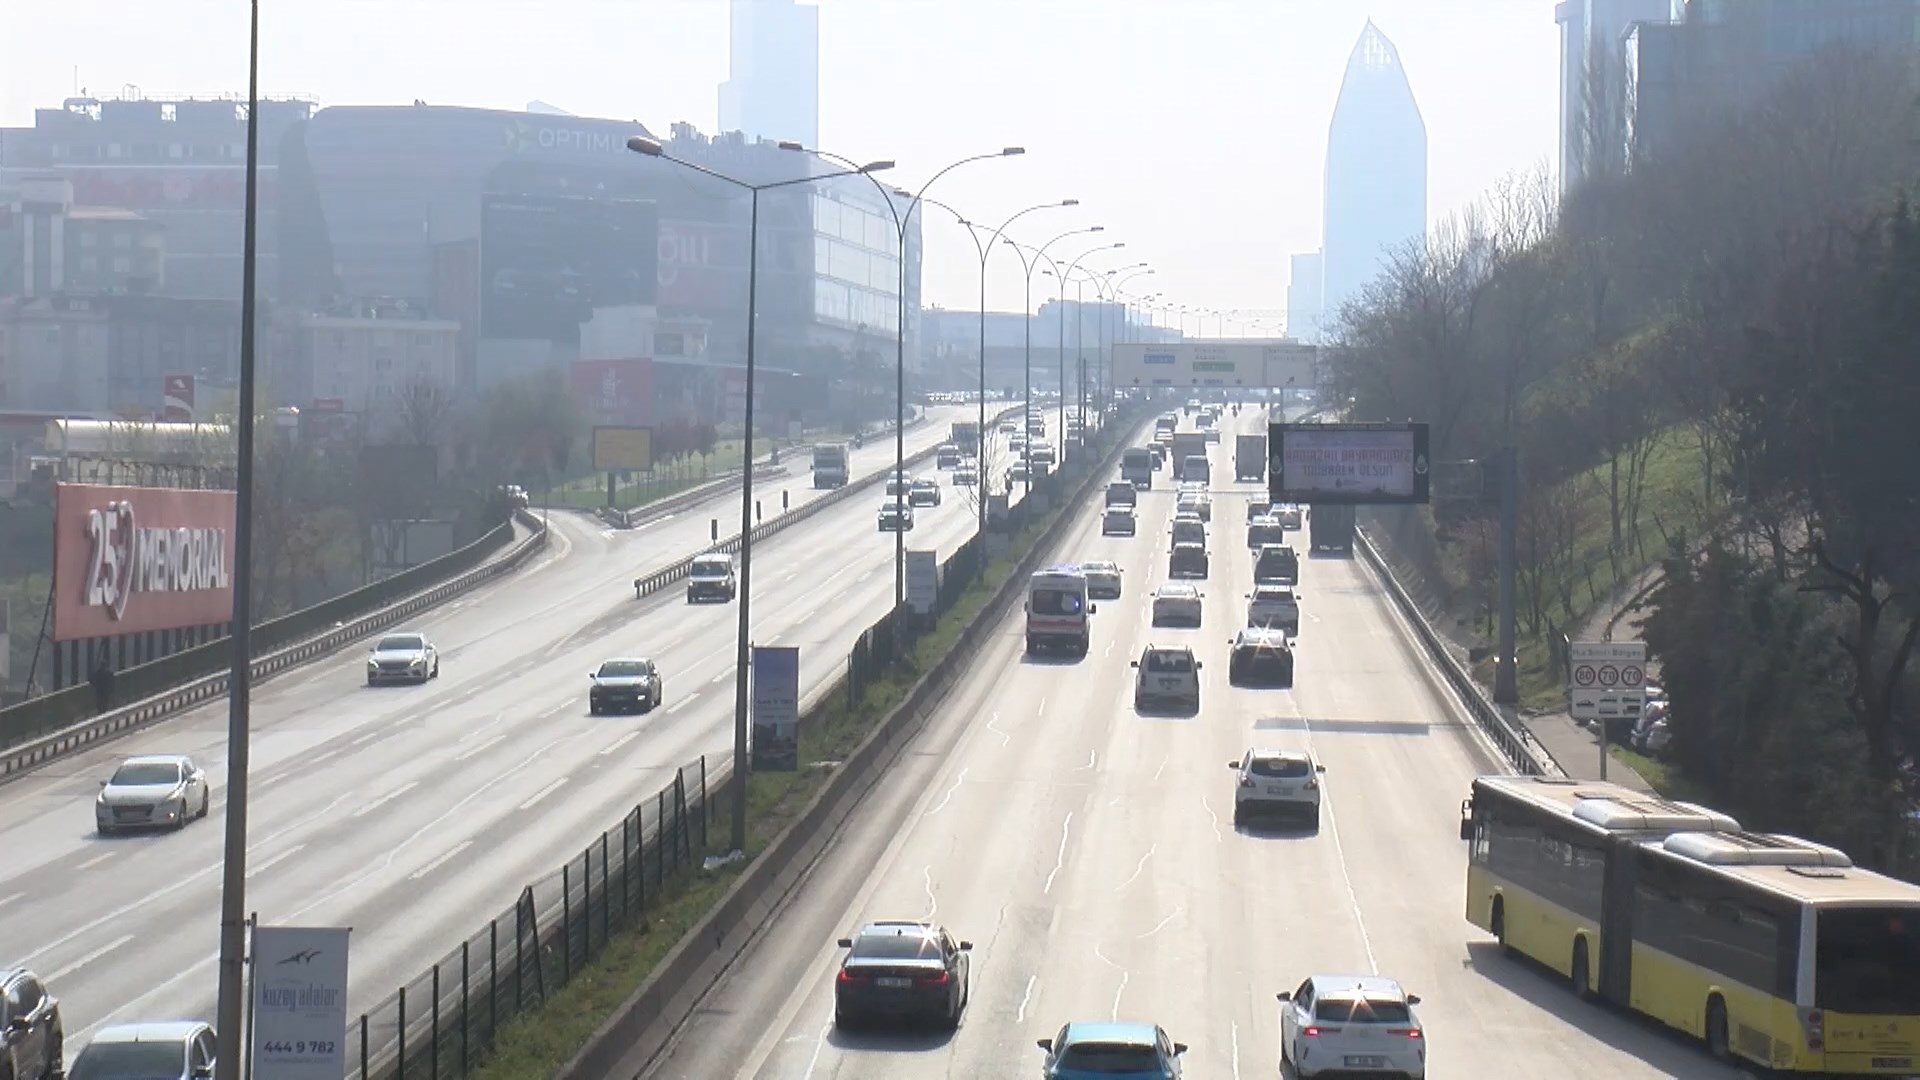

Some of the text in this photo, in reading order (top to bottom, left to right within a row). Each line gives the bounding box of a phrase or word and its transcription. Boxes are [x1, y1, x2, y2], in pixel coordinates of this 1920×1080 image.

[537, 127, 631, 152] OPTIMU
[138, 528, 228, 593] MEMORIAL
[1602, 671, 1616, 681] 70
[1626, 671, 1640, 681] 70
[262, 983, 297, 1012] kuzey
[264, 1041, 335, 1054] 444 9 782
